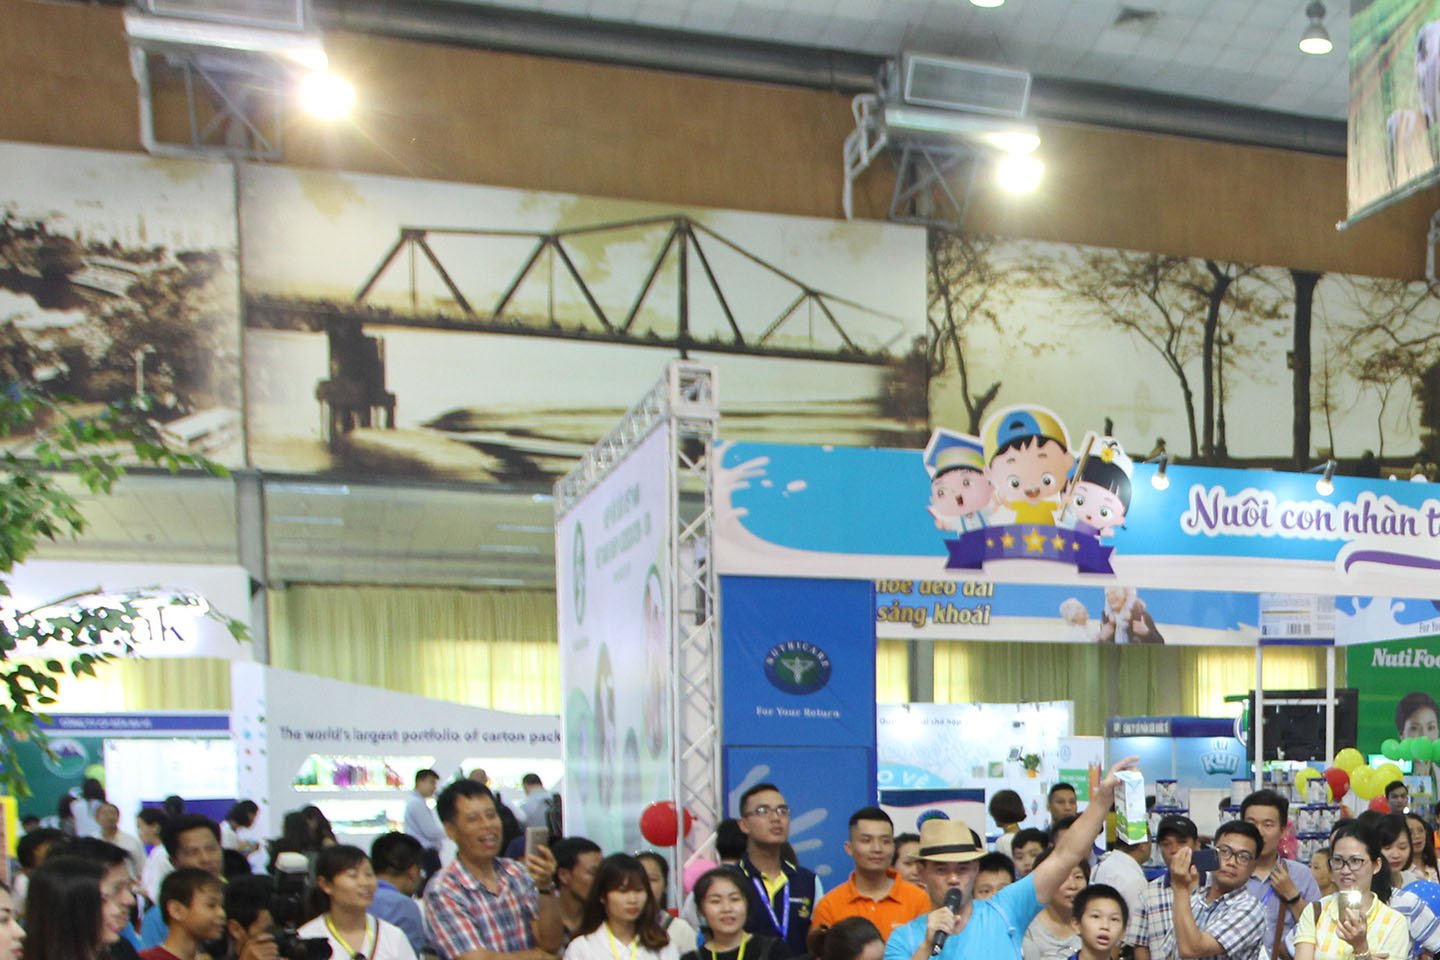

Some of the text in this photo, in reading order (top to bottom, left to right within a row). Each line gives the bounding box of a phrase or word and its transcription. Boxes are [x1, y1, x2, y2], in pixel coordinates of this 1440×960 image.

[1187, 491, 1272, 529] Nuôi
[1280, 505, 1335, 532] con
[1344, 500, 1420, 537] nhàn
[280, 726, 301, 740] The
[464, 728, 479, 741] of
